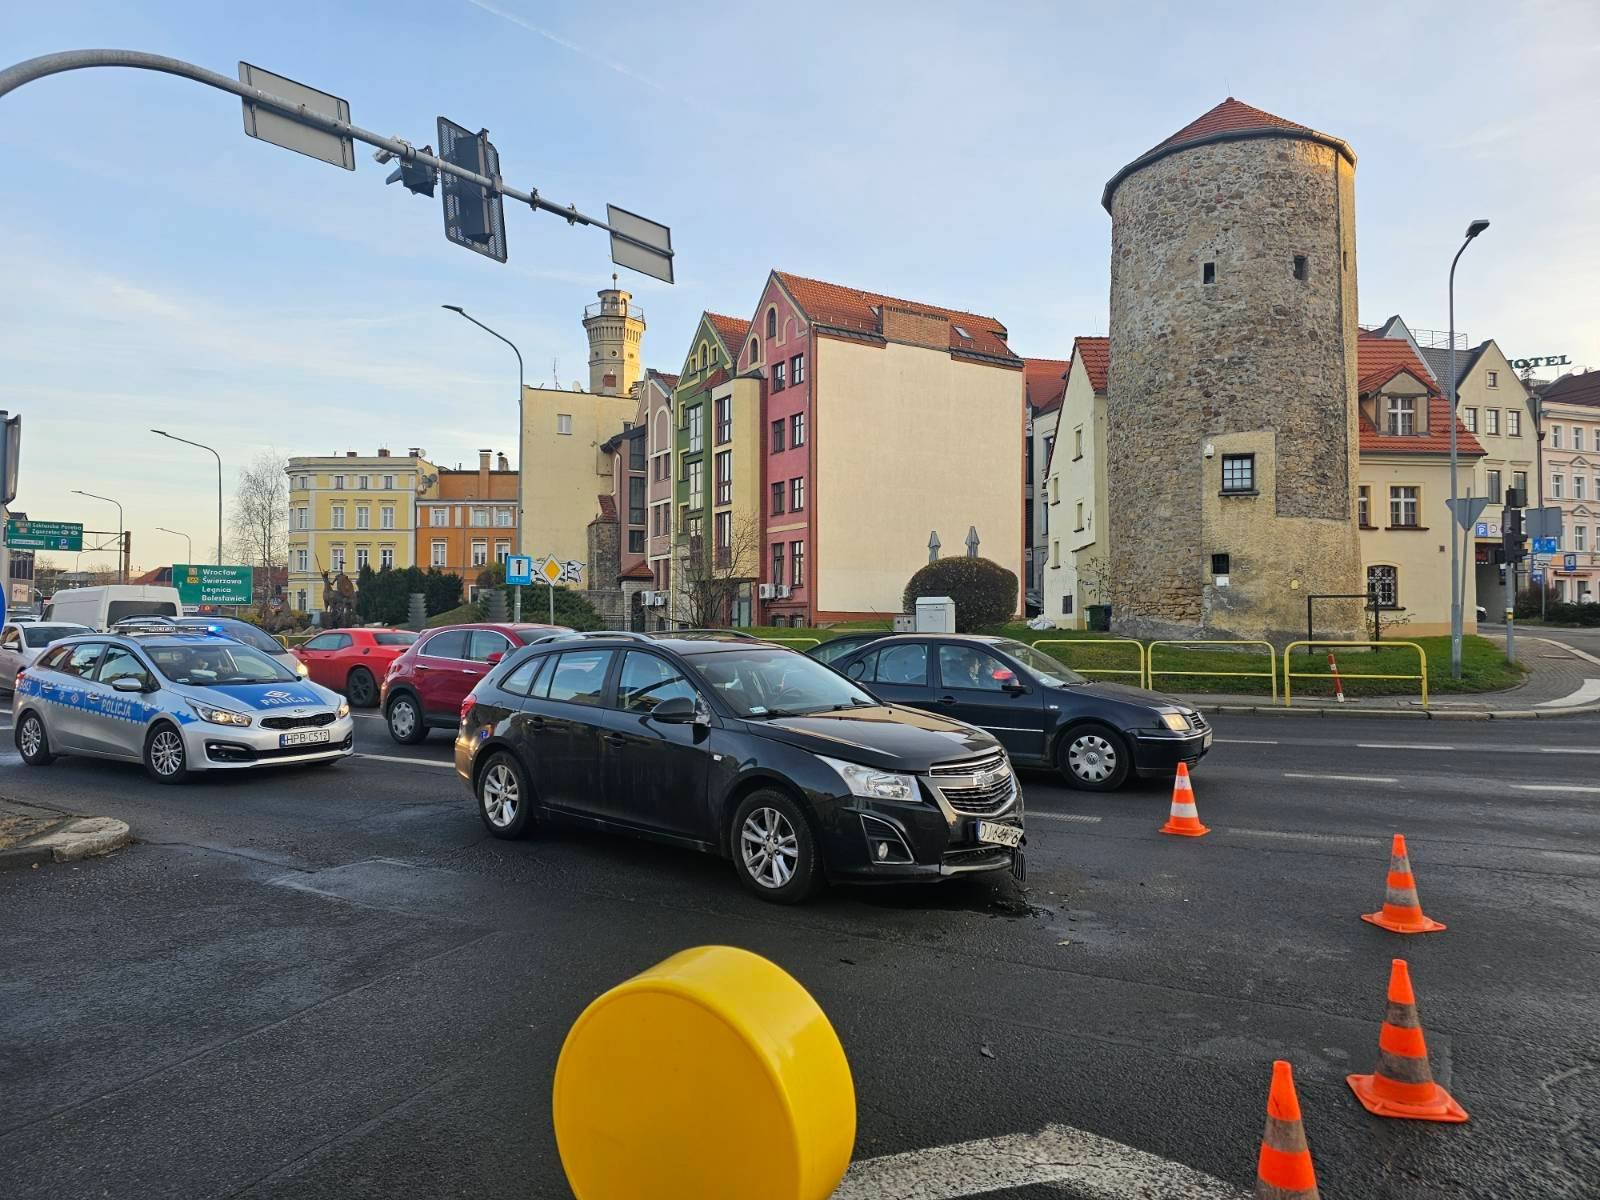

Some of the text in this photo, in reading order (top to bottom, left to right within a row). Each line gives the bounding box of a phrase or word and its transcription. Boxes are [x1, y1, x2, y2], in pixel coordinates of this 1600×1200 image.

[202, 576, 242, 584] Świerzawa
[201, 594, 247, 602] Bolesławiec
[260, 696, 314, 706] POLICJA
[101, 699, 131, 717] POLICJA
[286, 731, 327, 744] HPB C512
